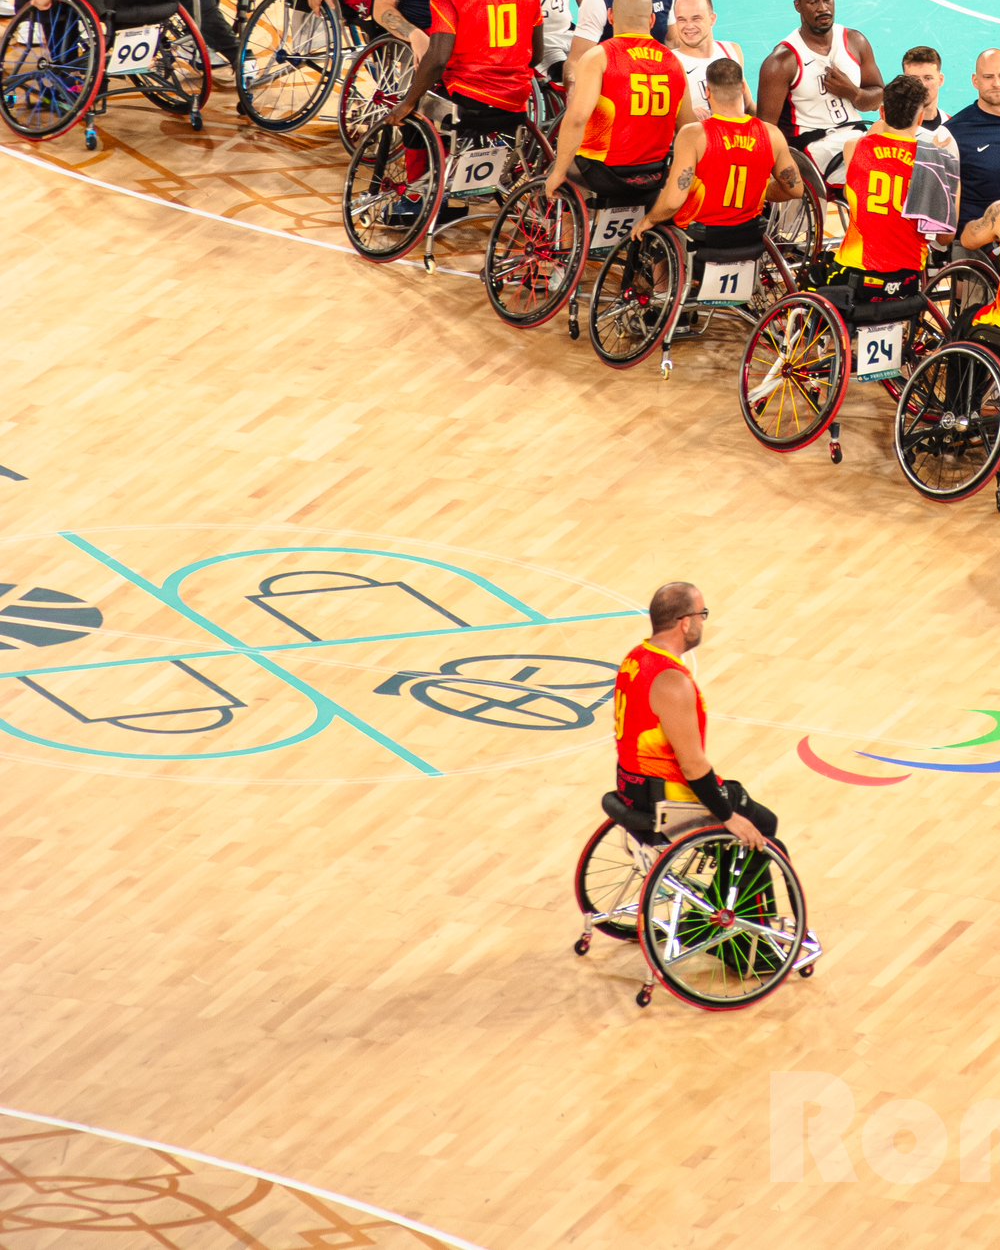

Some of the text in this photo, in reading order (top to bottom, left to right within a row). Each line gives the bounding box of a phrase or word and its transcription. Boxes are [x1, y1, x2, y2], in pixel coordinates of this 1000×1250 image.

[487, 3, 517, 48] 10
[118, 42, 150, 64] 90
[627, 47, 663, 63] PRIETO
[630, 73, 671, 116] 55
[826, 98, 849, 125] 8
[464, 161, 494, 183] 10
[722, 164, 747, 209] 11
[603, 218, 635, 240] 55
[719, 272, 740, 294] 11
[867, 339, 893, 365] 24
